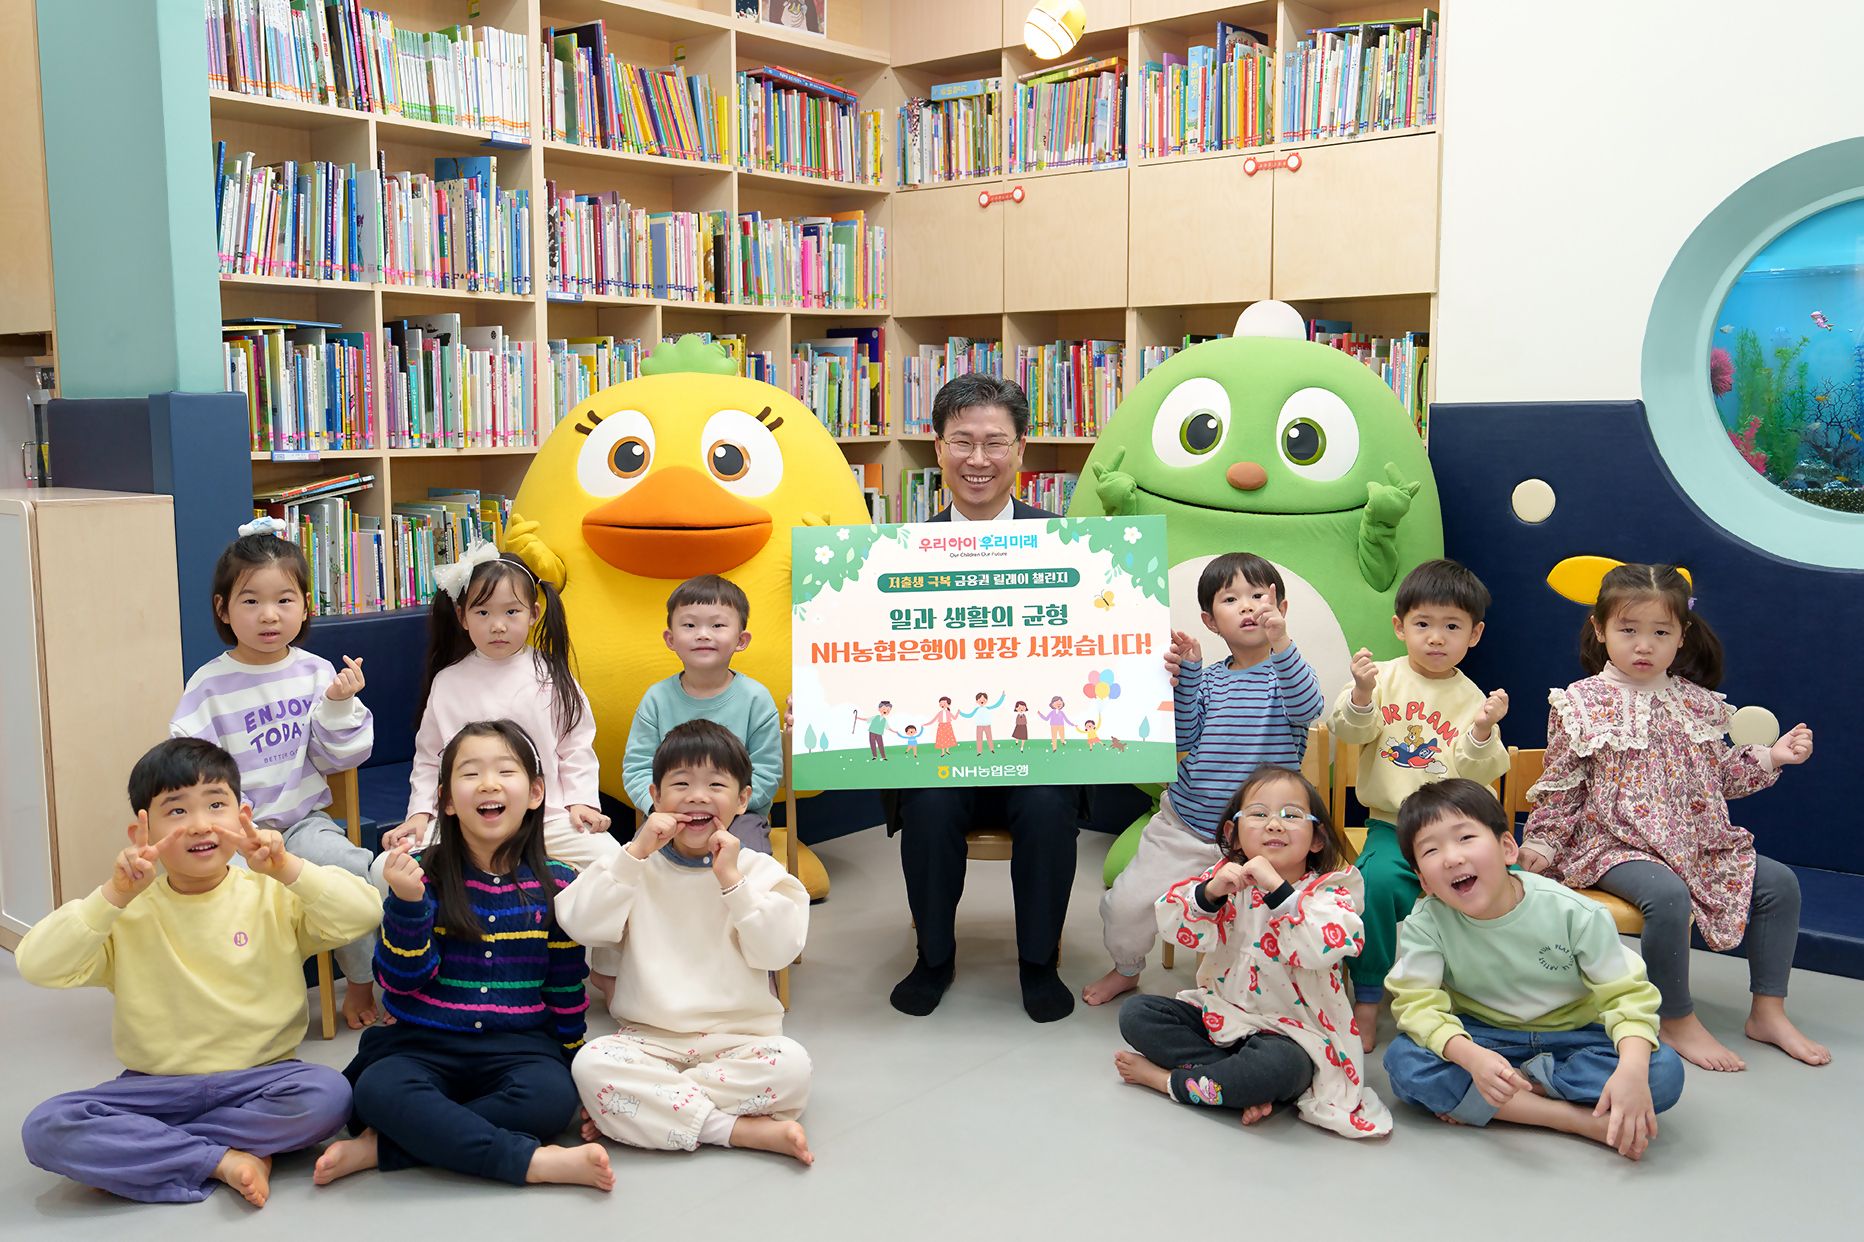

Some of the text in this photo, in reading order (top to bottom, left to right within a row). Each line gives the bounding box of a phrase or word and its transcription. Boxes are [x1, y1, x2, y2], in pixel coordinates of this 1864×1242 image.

[919, 534, 1038, 552] 우리아이 우리미래
[888, 571, 1068, 588] 저출생 극복 금융권 릴레이 챌린지
[890, 604, 1069, 630] 일과 생활의 균형
[811, 632, 1152, 664] NH농협은행이 앞장 서겠습니다!
[244, 699, 312, 733] ENJOY
[1381, 703, 1402, 726] IR
[250, 722, 305, 754] TODA
[952, 764, 1029, 778] NH농협은행
